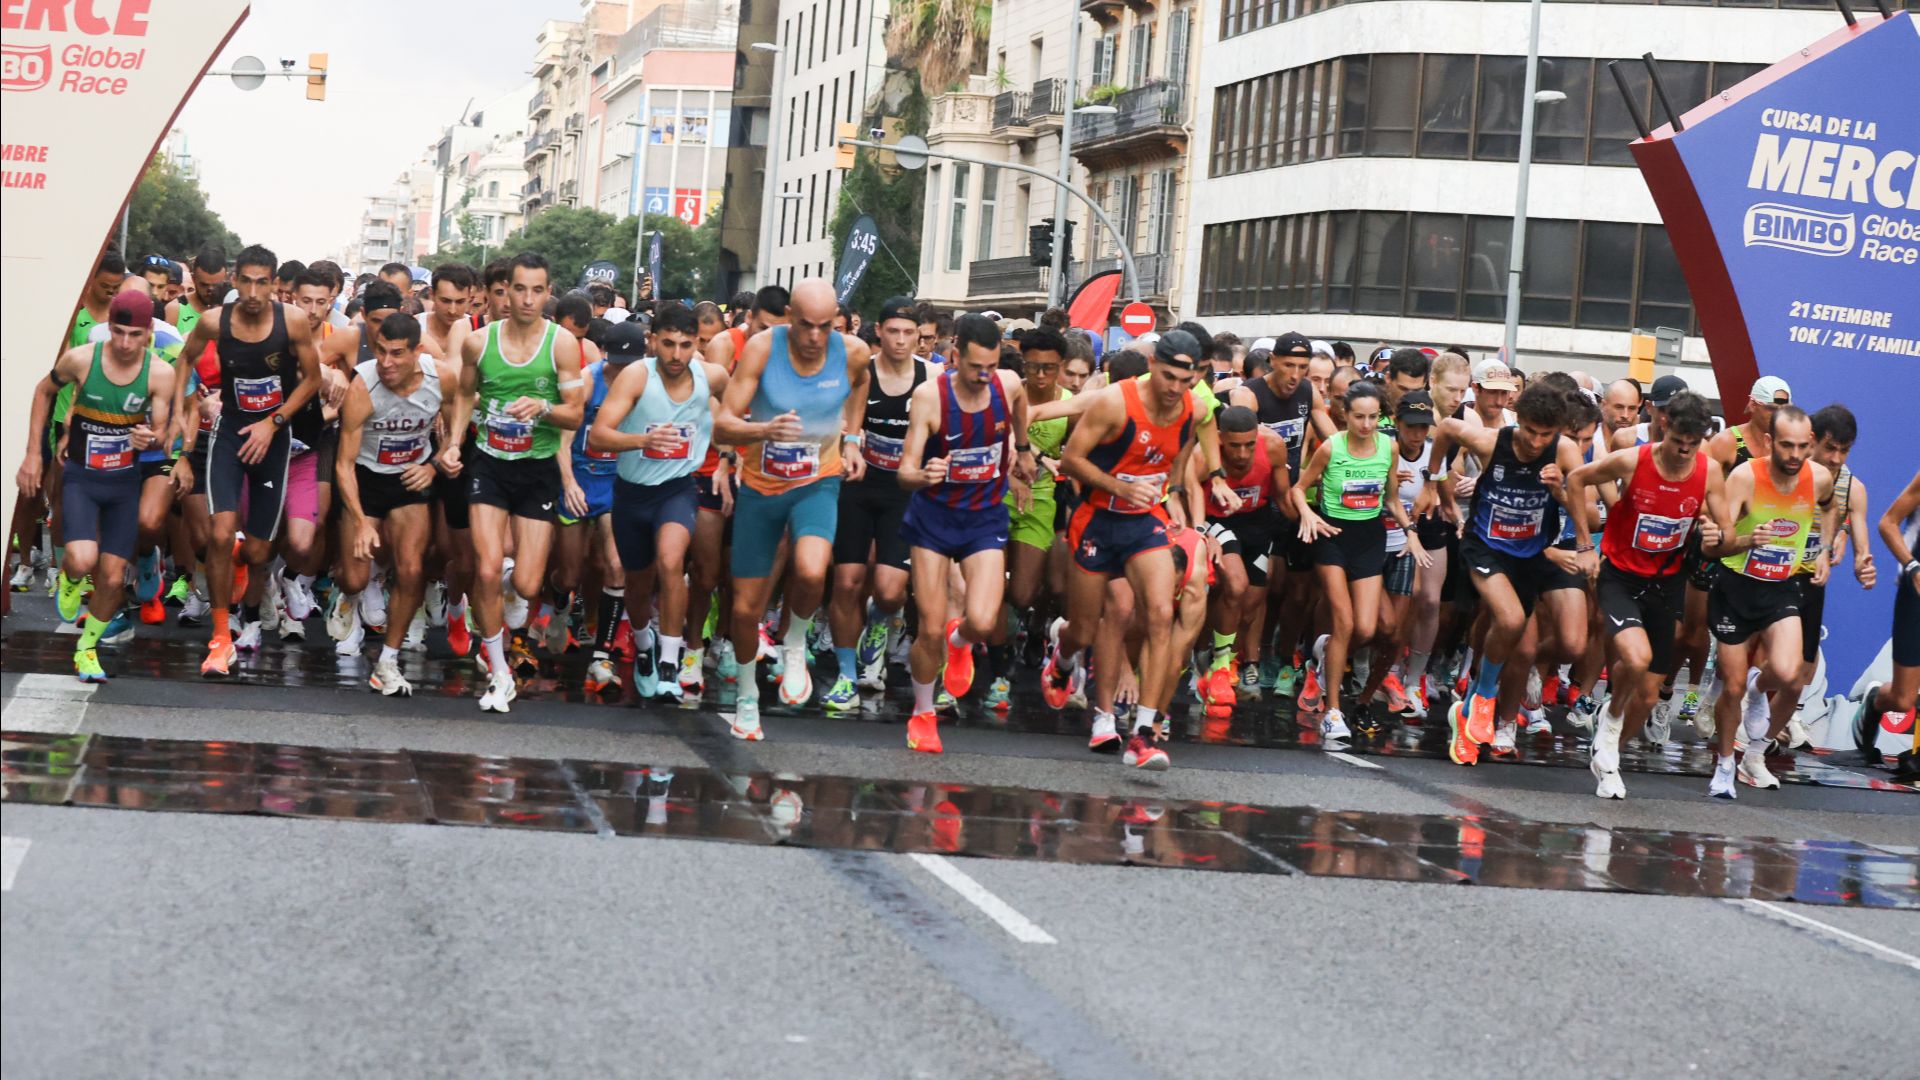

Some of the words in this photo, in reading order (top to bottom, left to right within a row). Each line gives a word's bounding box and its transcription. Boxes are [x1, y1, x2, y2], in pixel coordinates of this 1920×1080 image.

[61, 44, 145, 70] Global
[59, 70, 128, 95] Race
[1761, 107, 1822, 134] CURSA
[1825, 116, 1851, 137] DE
[1853, 120, 1877, 141] LA
[851, 228, 878, 256] 3:45
[1753, 212, 1848, 247] BIMBO
[1859, 238, 1918, 265] Race
[586, 267, 615, 281] 4:00
[1788, 300, 1811, 319] 21
[1811, 303, 1893, 329] SETEMBRE
[1789, 325, 1821, 345] 10K
[1831, 331, 1856, 349] 2K
[1345, 469, 1367, 478] B100
[1647, 535, 1674, 543] MARC
[1754, 562, 1785, 573] ARTUR
